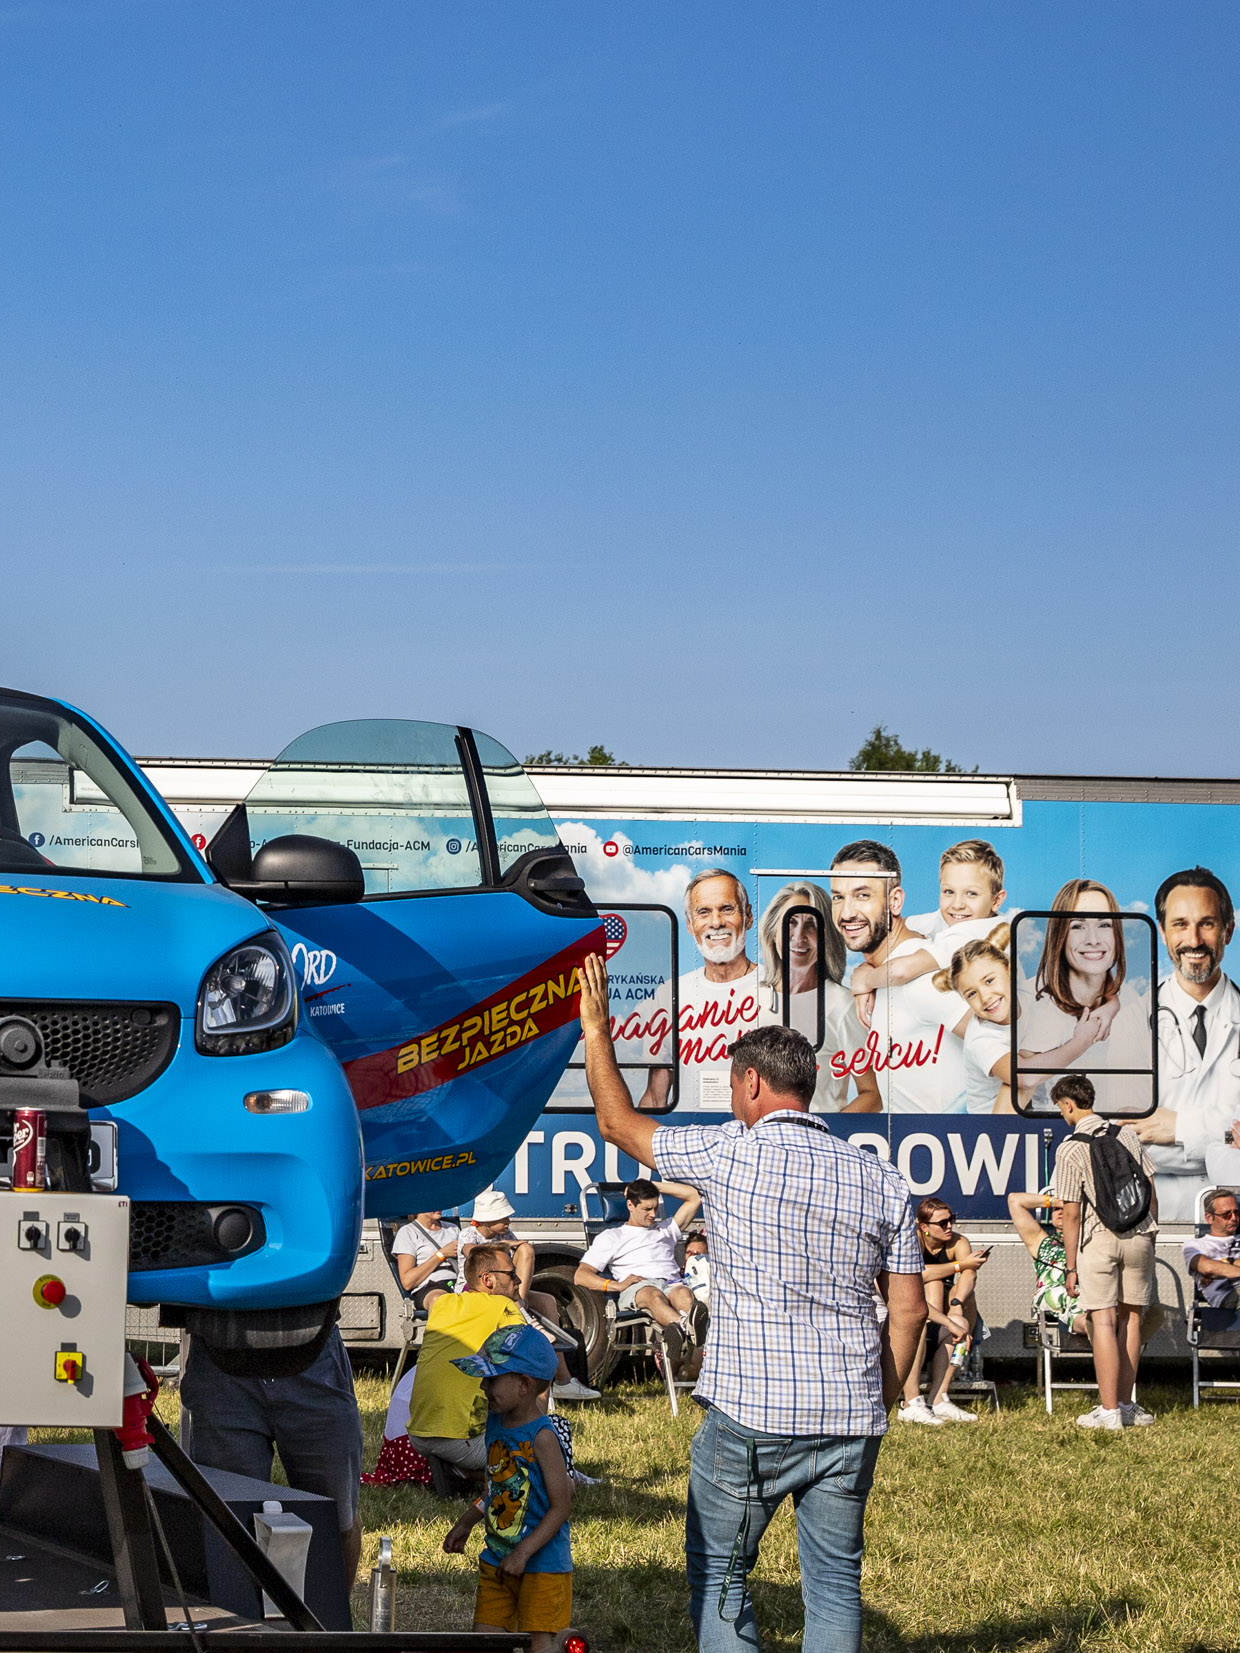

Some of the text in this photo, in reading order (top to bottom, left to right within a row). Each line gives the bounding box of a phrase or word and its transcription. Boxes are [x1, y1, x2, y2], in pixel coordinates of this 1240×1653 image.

[623, 844, 747, 857] @AmericanCarsMania
[291, 943, 337, 991] ORD
[608, 972, 665, 985] RYKAŃSKA
[625, 988, 655, 1000] ACM
[310, 1003, 345, 1017] KATOWICE
[396, 966, 584, 1075] BEZPIECZNA
[456, 1018, 540, 1072] JAZDA
[830, 1023, 945, 1079] sercu!
